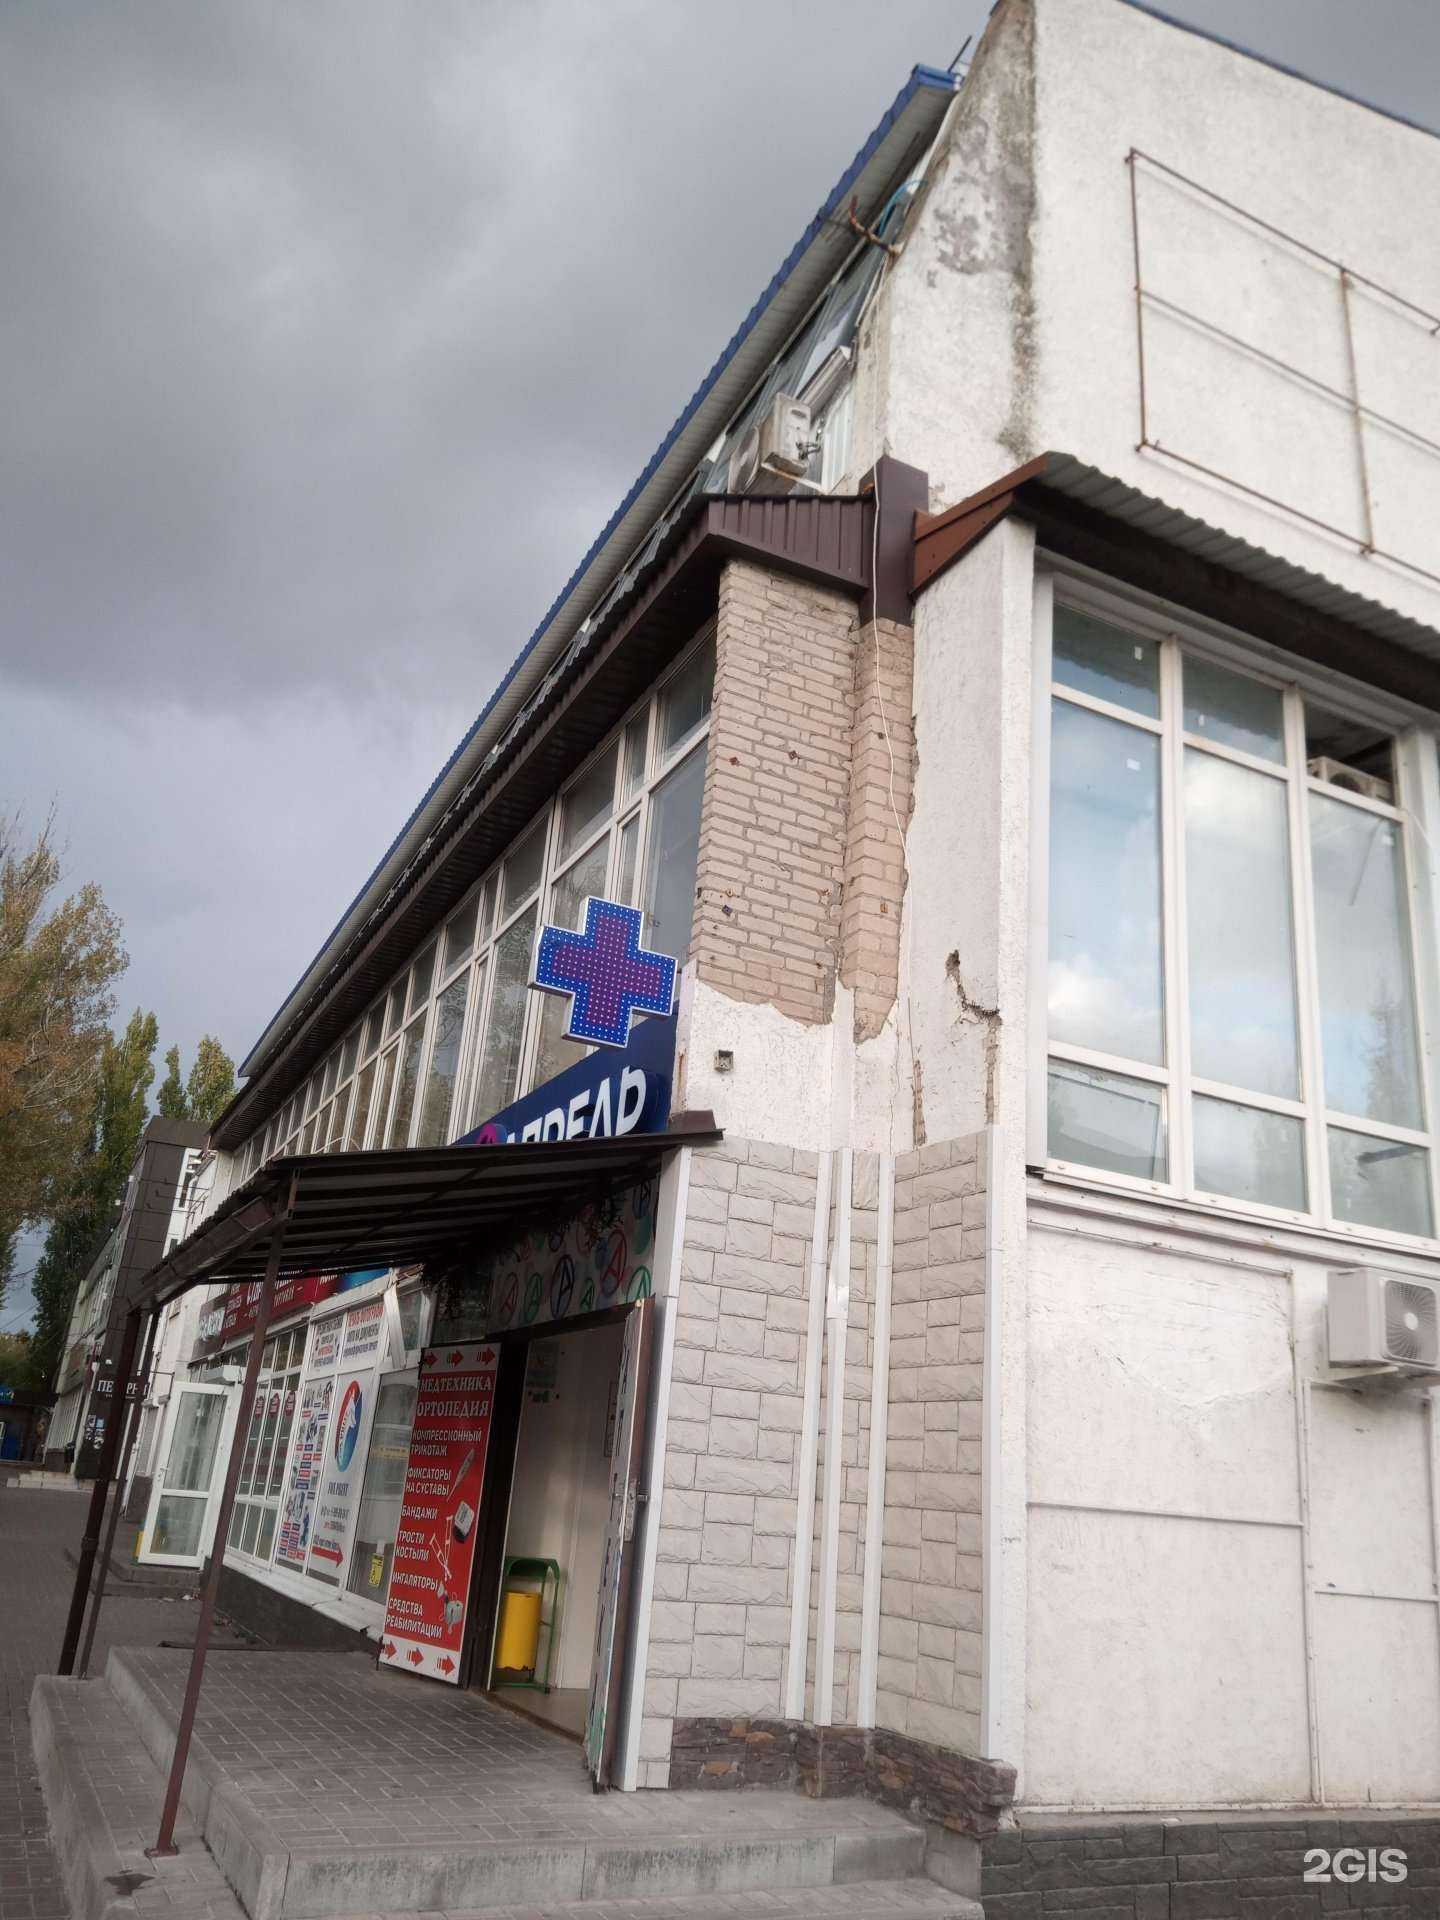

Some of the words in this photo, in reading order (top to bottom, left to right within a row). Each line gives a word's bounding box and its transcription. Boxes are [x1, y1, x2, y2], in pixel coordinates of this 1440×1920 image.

[420, 1375, 492, 1393] МЕДТЕХНИКА
[417, 1400, 488, 1418] ОРТОПЕДИЯ
[412, 1427, 482, 1442] КОМПРЕССИОННЫЙ
[410, 1444, 448, 1457] ТРИКОТАЖ
[408, 1467, 451, 1480] ФИКСАТОРЫ
[405, 1482, 416, 1494] НА
[416, 1483, 449, 1496] СУСТАВЫ
[401, 1505, 438, 1520] БАНДАЖИ
[398, 1530, 425, 1544] ТРОСТИ
[395, 1546, 430, 1561] КОСТЫЛИ
[392, 1571, 438, 1591] ИНГАЛЯТОРЫ
[388, 1597, 423, 1617] СРЕДСТВА
[385, 1613, 443, 1639] РЕАБИЛИТАЦИИ
